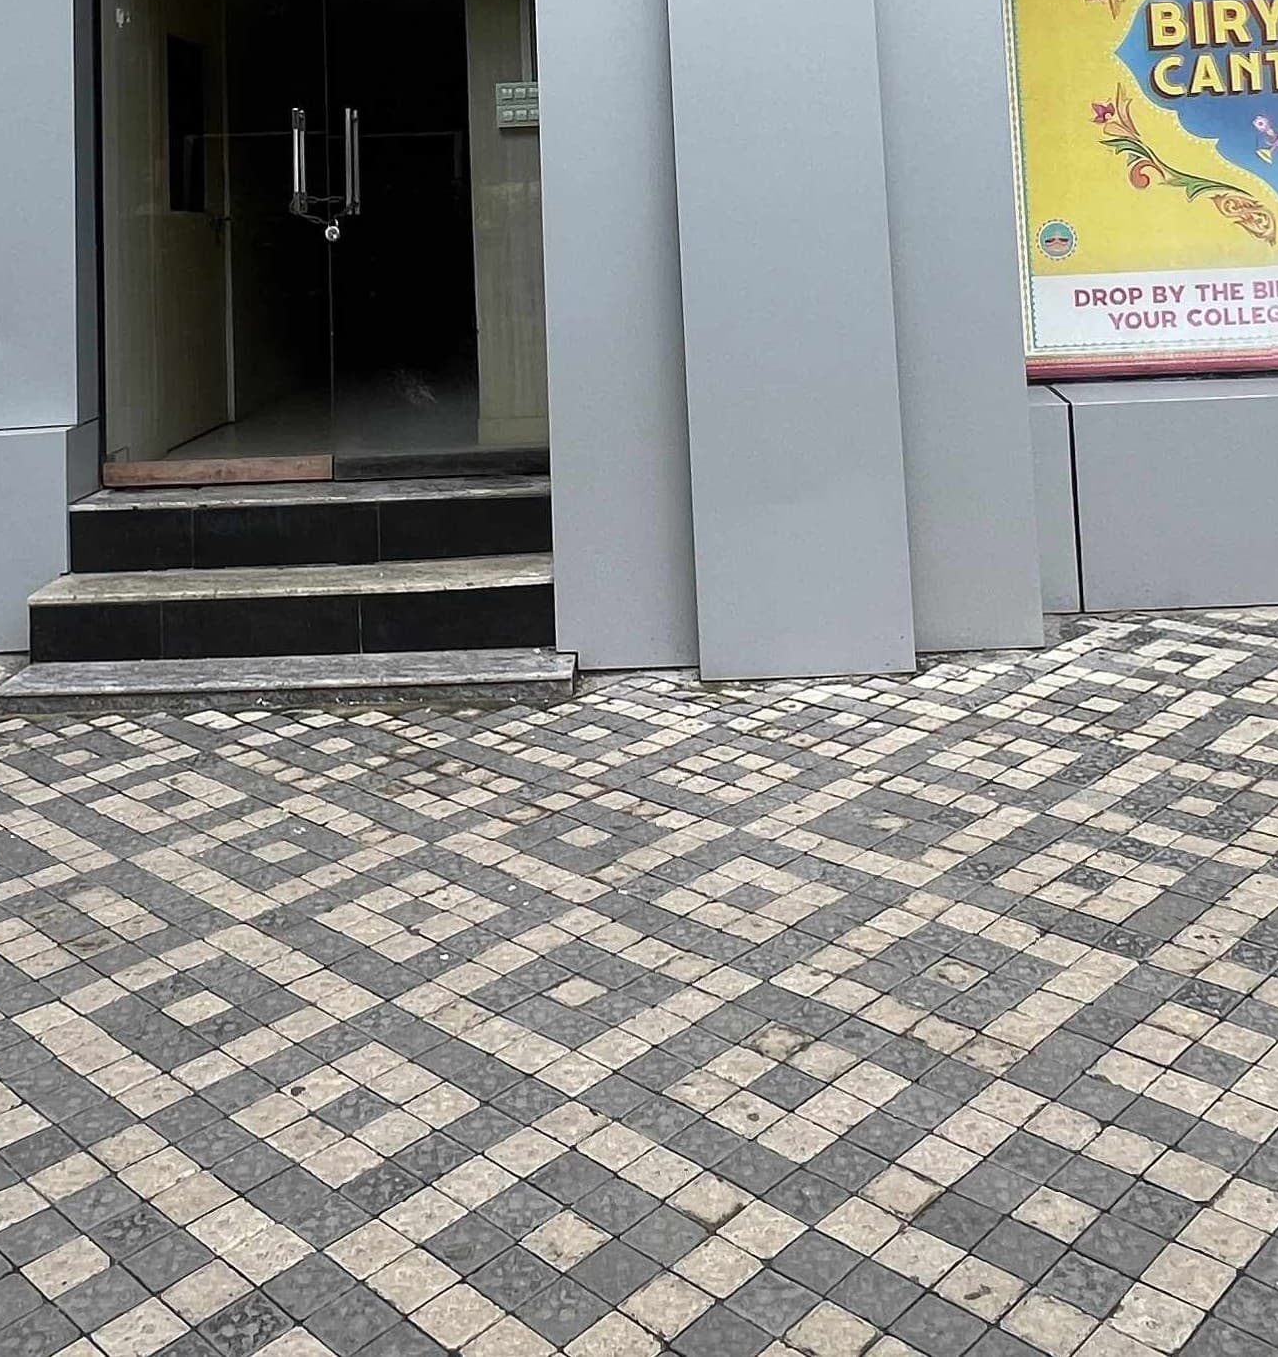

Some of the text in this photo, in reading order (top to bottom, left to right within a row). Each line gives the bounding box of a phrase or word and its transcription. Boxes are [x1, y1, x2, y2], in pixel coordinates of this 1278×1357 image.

[1074, 287, 1142, 308] DROP
[1153, 285, 1185, 304] BY
[1195, 283, 1244, 302] THE
[1108, 310, 1177, 330] YOUR
